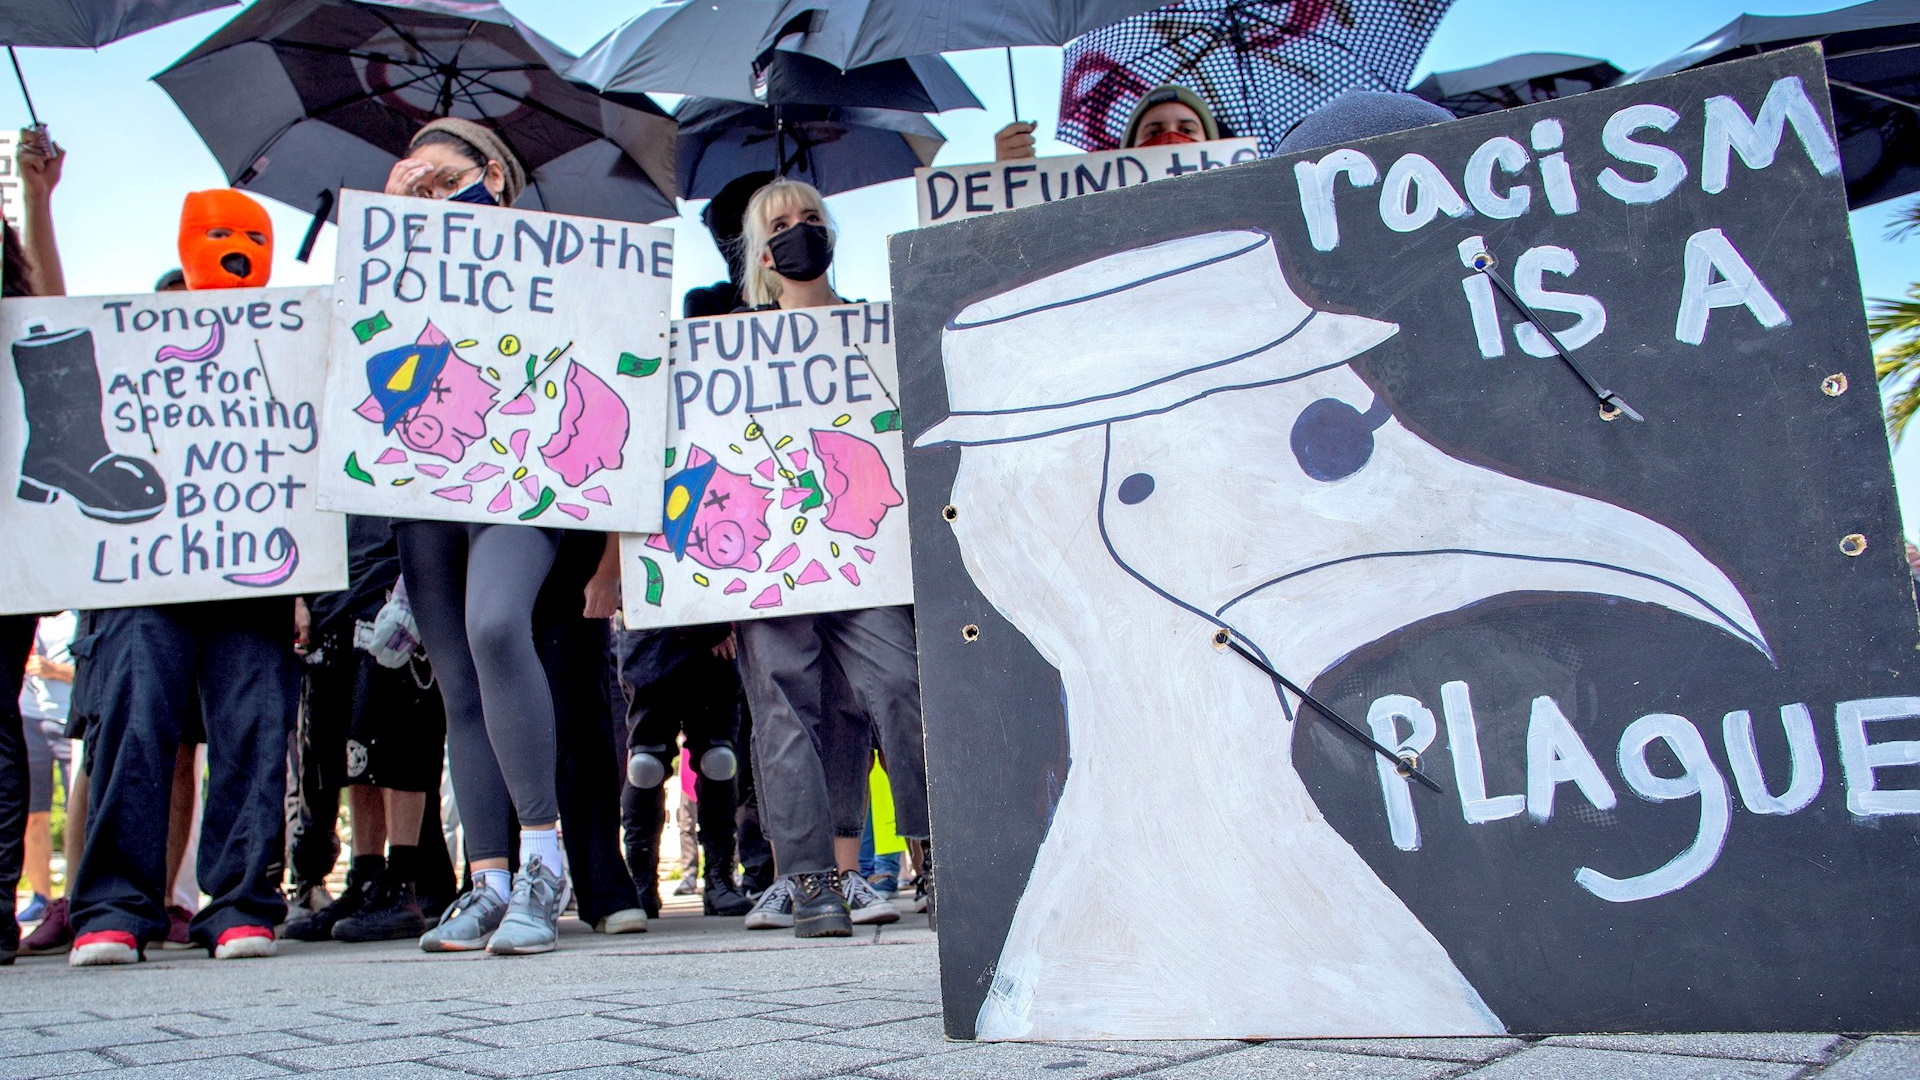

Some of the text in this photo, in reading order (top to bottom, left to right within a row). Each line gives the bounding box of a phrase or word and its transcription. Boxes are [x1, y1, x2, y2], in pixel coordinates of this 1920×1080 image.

[926, 156, 1148, 220] DEFUND
[363, 206, 584, 267] DEFUND
[359, 257, 554, 313] POLICE
[1675, 227, 1791, 346] A
[669, 304, 890, 364] FUND TH
[673, 355, 872, 430] POLICE
